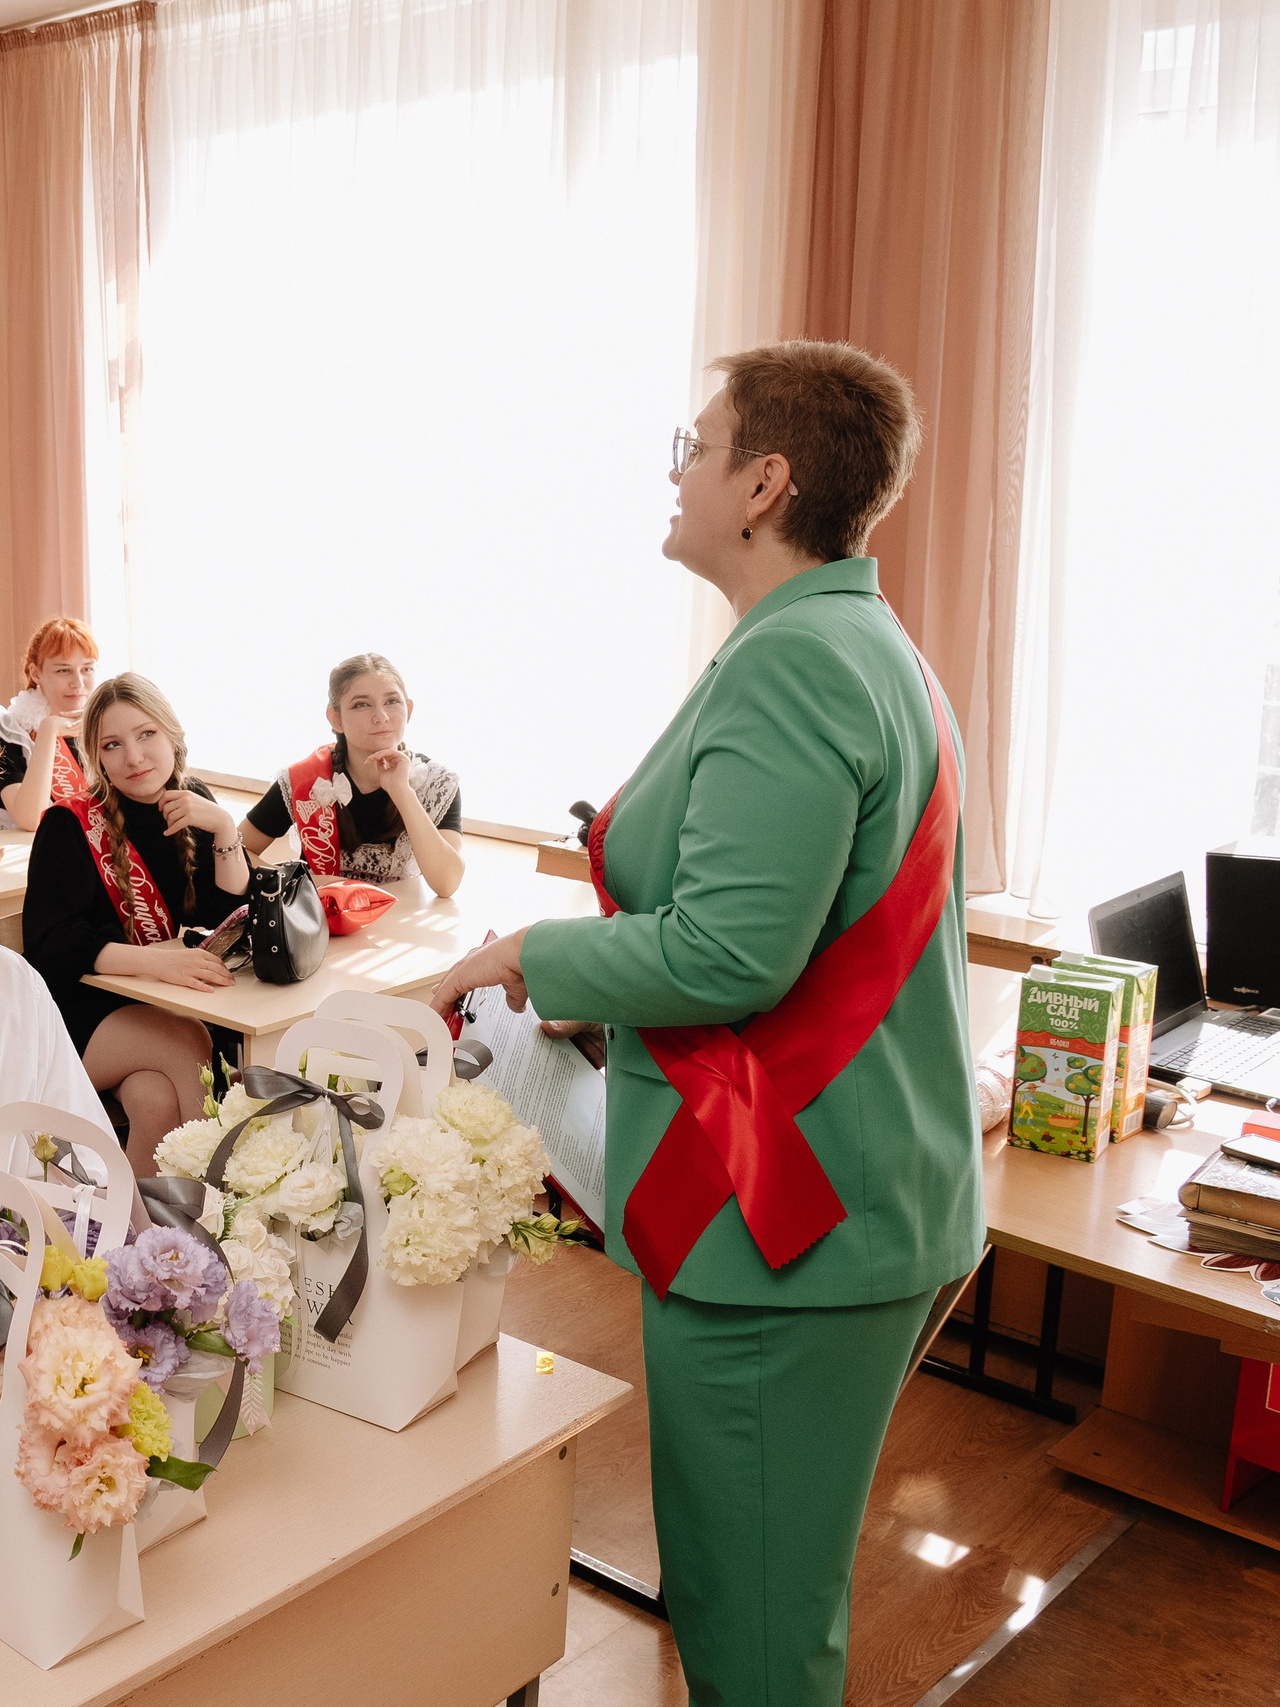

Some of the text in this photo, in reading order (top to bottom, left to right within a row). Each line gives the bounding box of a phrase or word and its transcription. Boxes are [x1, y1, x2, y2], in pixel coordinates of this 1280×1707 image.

[1028, 987, 1099, 1013] ДИВНЫЙ
[1046, 1004, 1080, 1021] САД
[1049, 1017, 1079, 1030] 100%
[1049, 1038, 1070, 1048] ЯБЛОКО
[338, 1349, 352, 1358] with
[330, 1354, 351, 1367] happier
